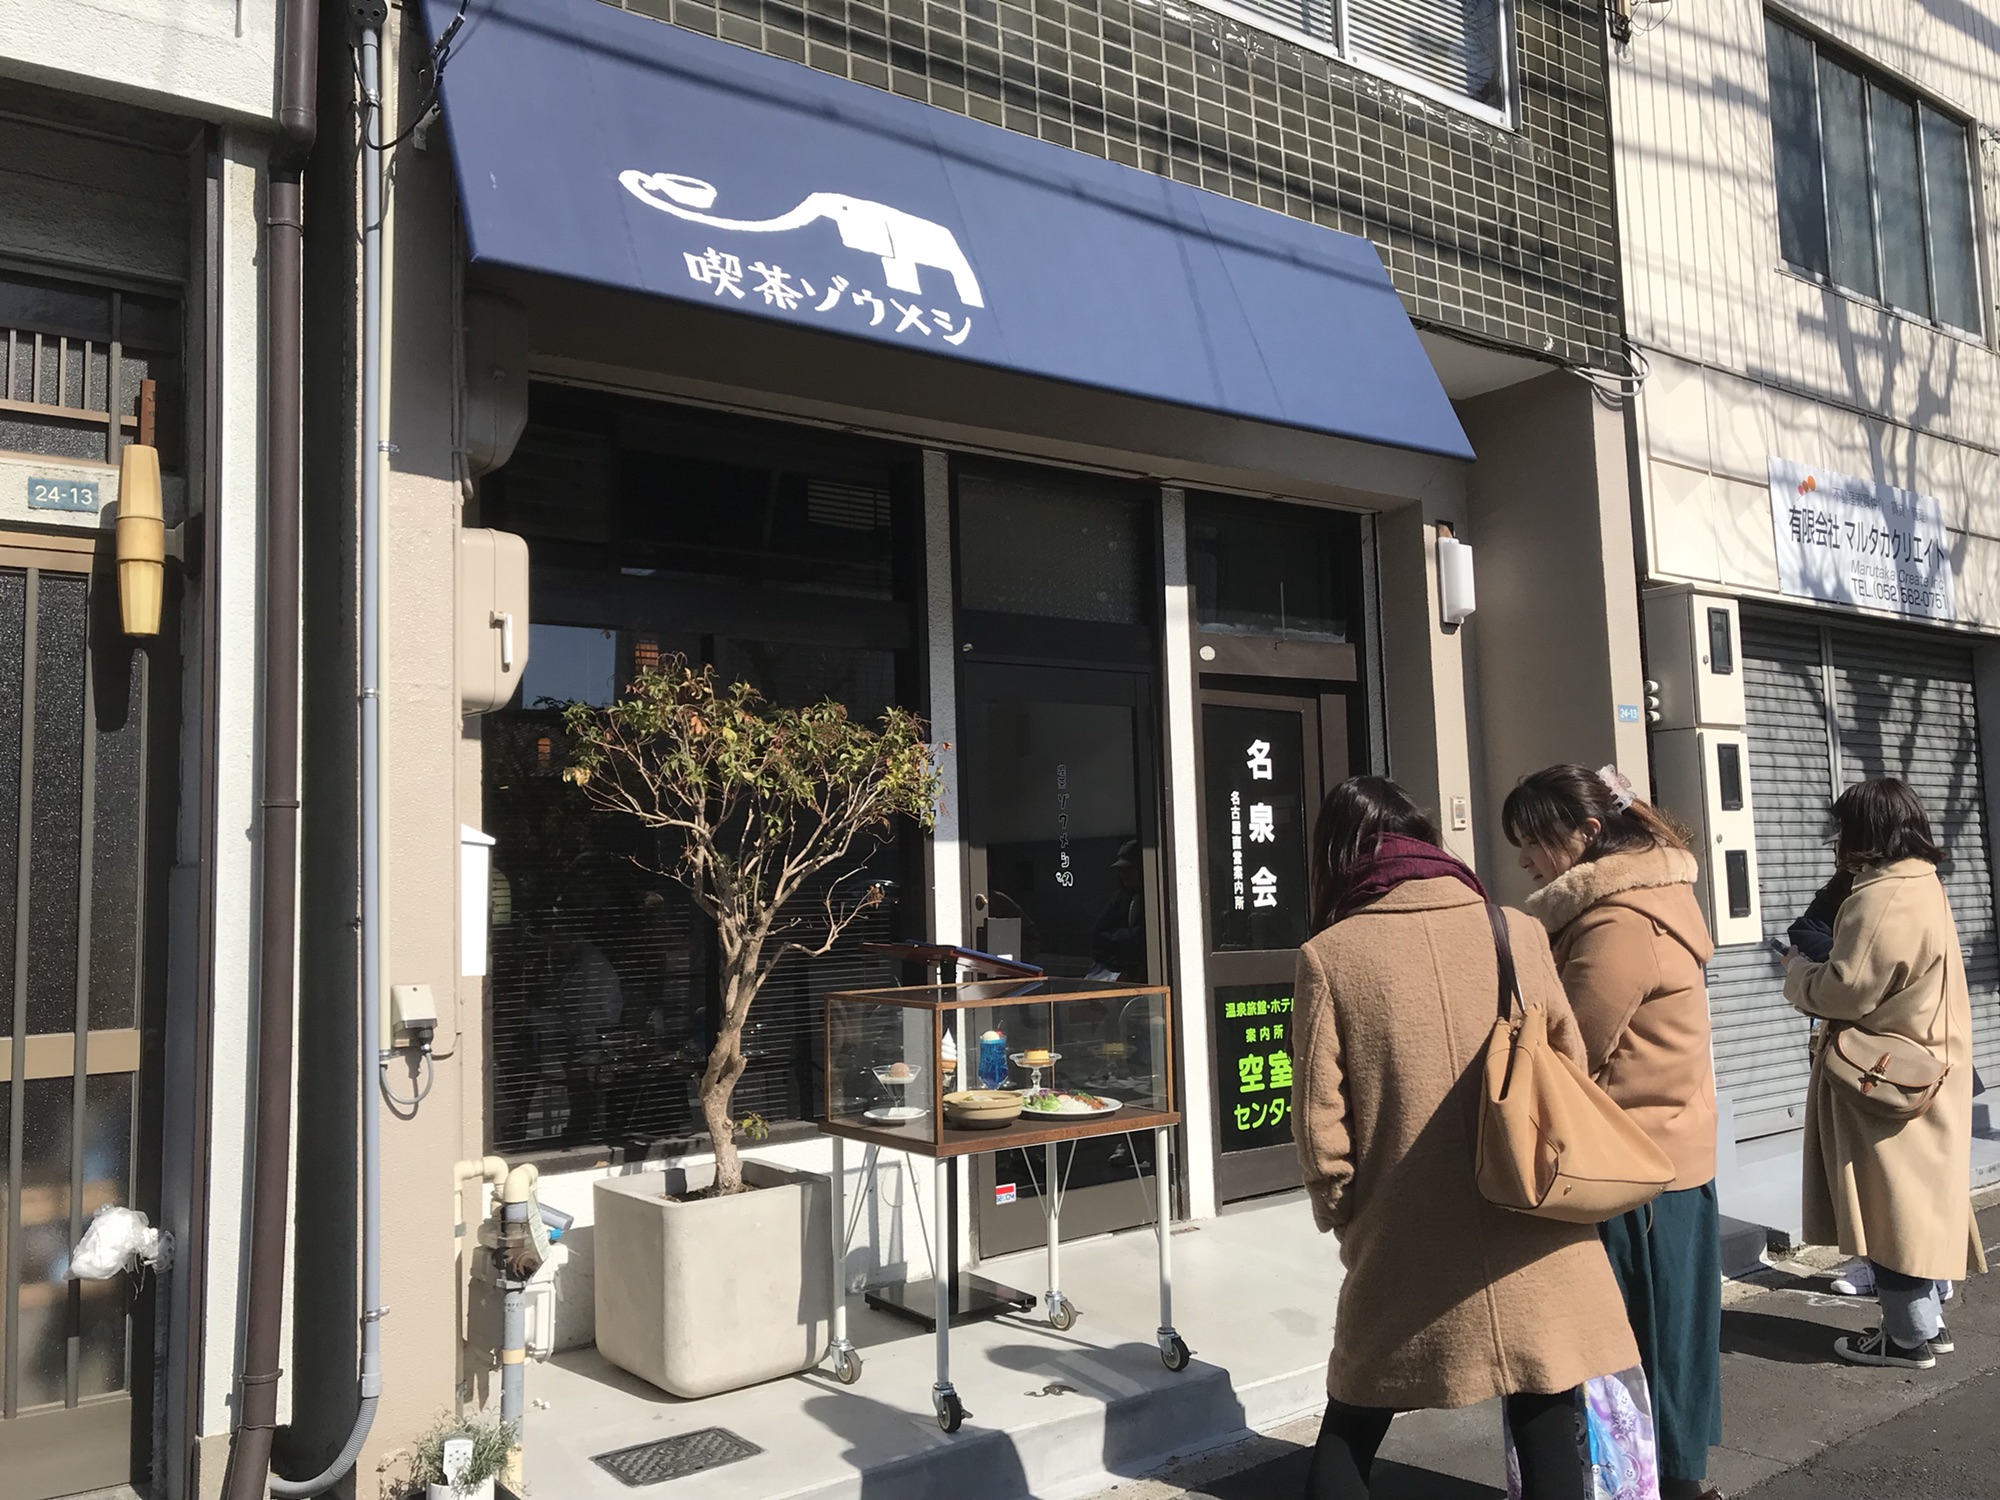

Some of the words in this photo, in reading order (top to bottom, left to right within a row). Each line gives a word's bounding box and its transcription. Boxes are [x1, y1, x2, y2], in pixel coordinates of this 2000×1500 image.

[683, 246, 971, 346] 喫茶ゾウメシ
[35, 484, 94, 506] 24-13
[1788, 505, 1841, 550] 有限会社
[1844, 520, 1945, 570] マルタカクリエイト
[1850, 559, 1896, 582] Marutaka
[1898, 569, 1930, 588] Create
[1620, 708, 1637, 719] 24-13
[1246, 739, 1277, 908] 名泉会
[1230, 791, 1244, 910] 名古屋直営案内所
[1225, 998, 1295, 1018] 温泉旅館・ホテ
[1245, 1024, 1284, 1043] 案内所
[1238, 1050, 1293, 1093] 空室
